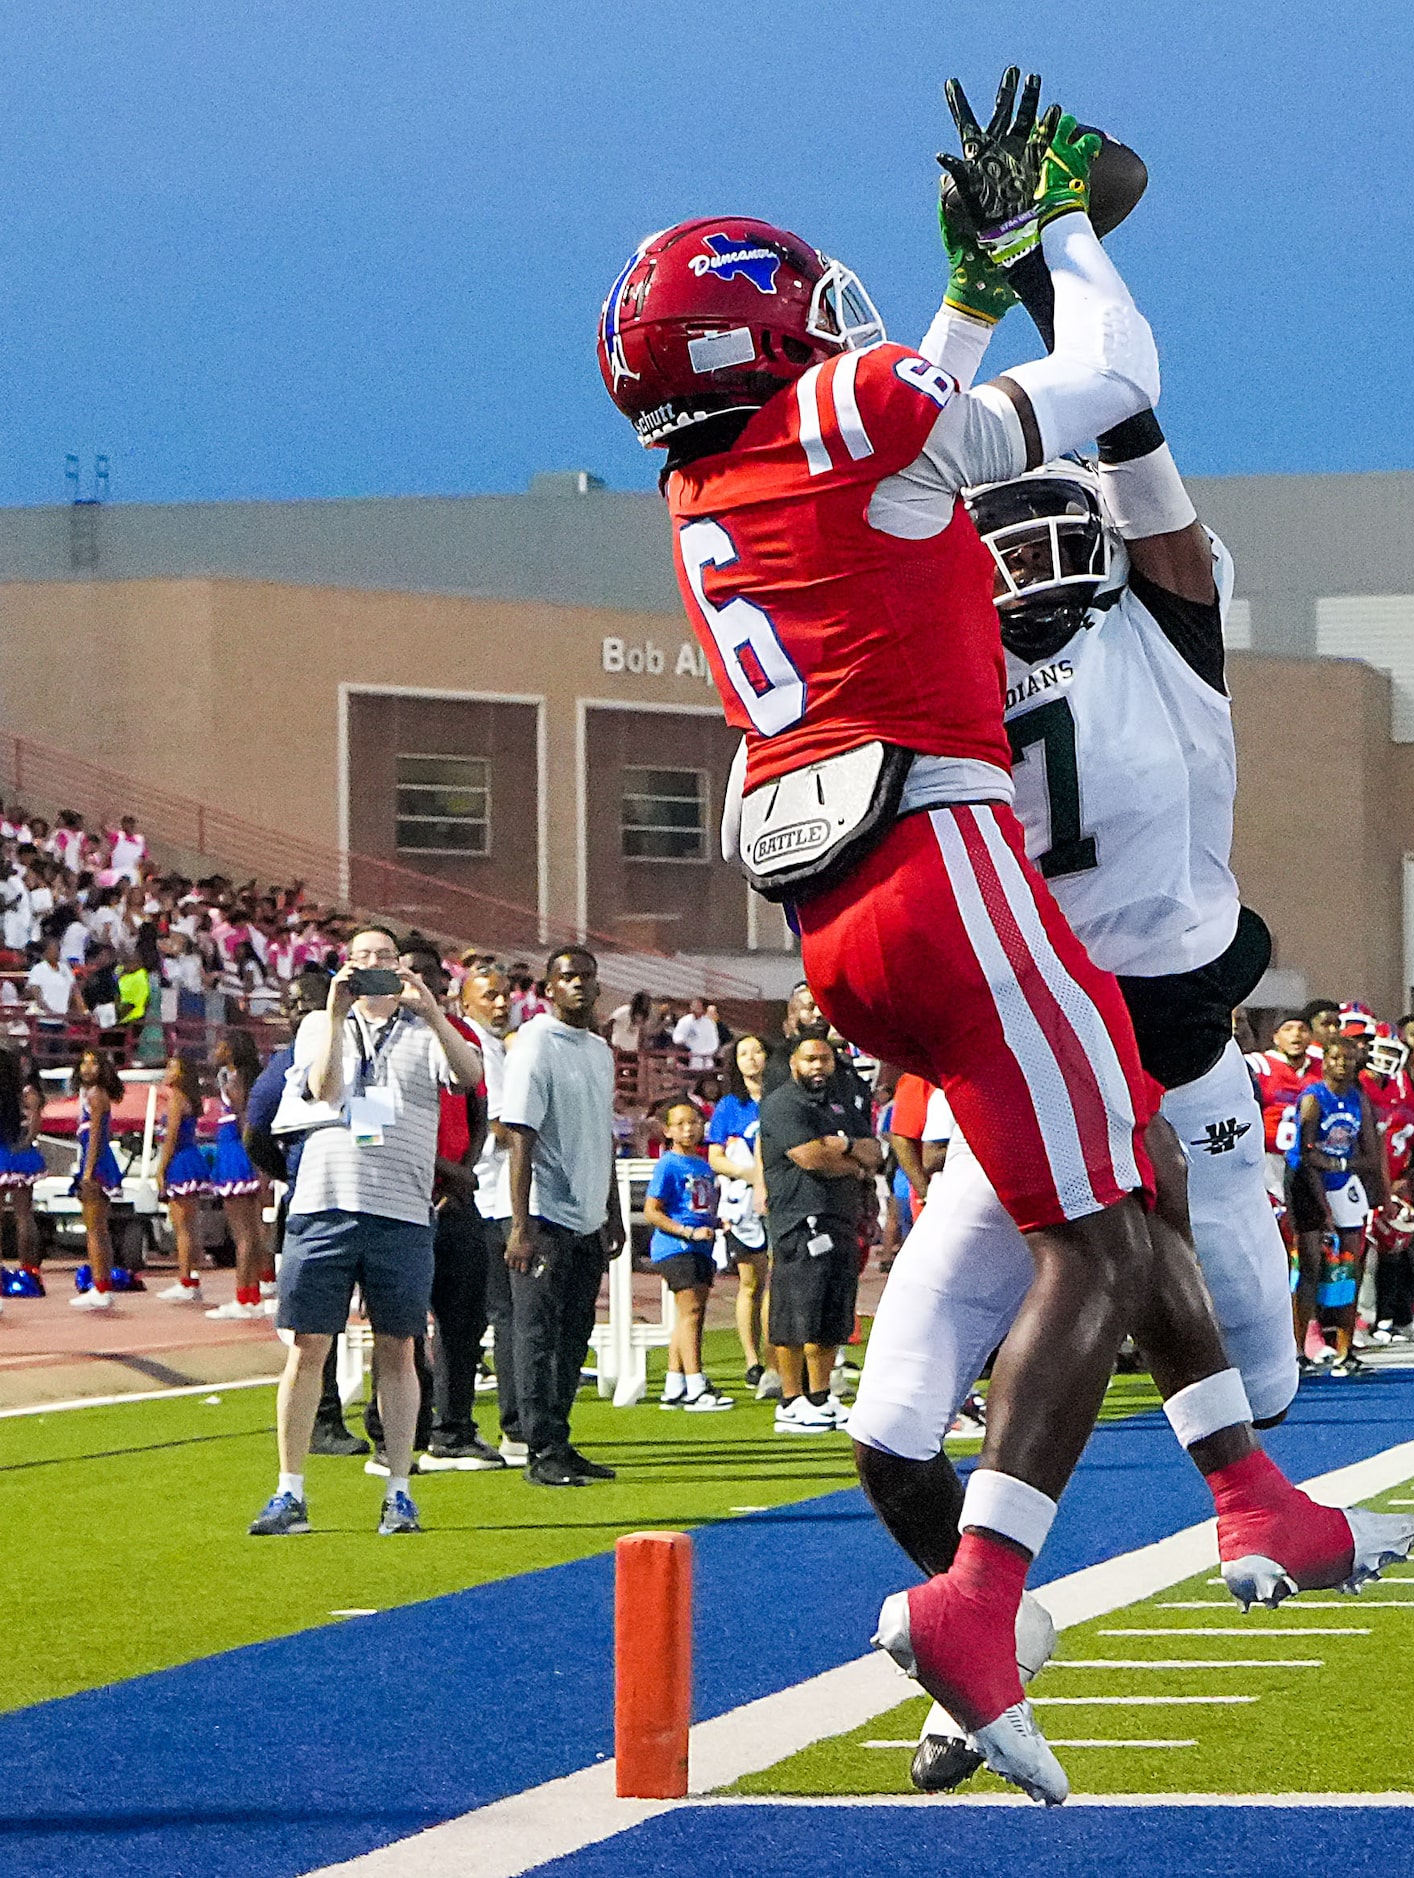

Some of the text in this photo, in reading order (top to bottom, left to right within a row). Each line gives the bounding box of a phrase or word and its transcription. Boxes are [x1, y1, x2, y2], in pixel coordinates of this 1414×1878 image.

[893, 357, 956, 409] 6
[679, 517, 808, 738] 6
[602, 636, 715, 687] Bob Al
[1005, 659, 1073, 712] DIANS
[758, 825, 823, 858] BATTLE
